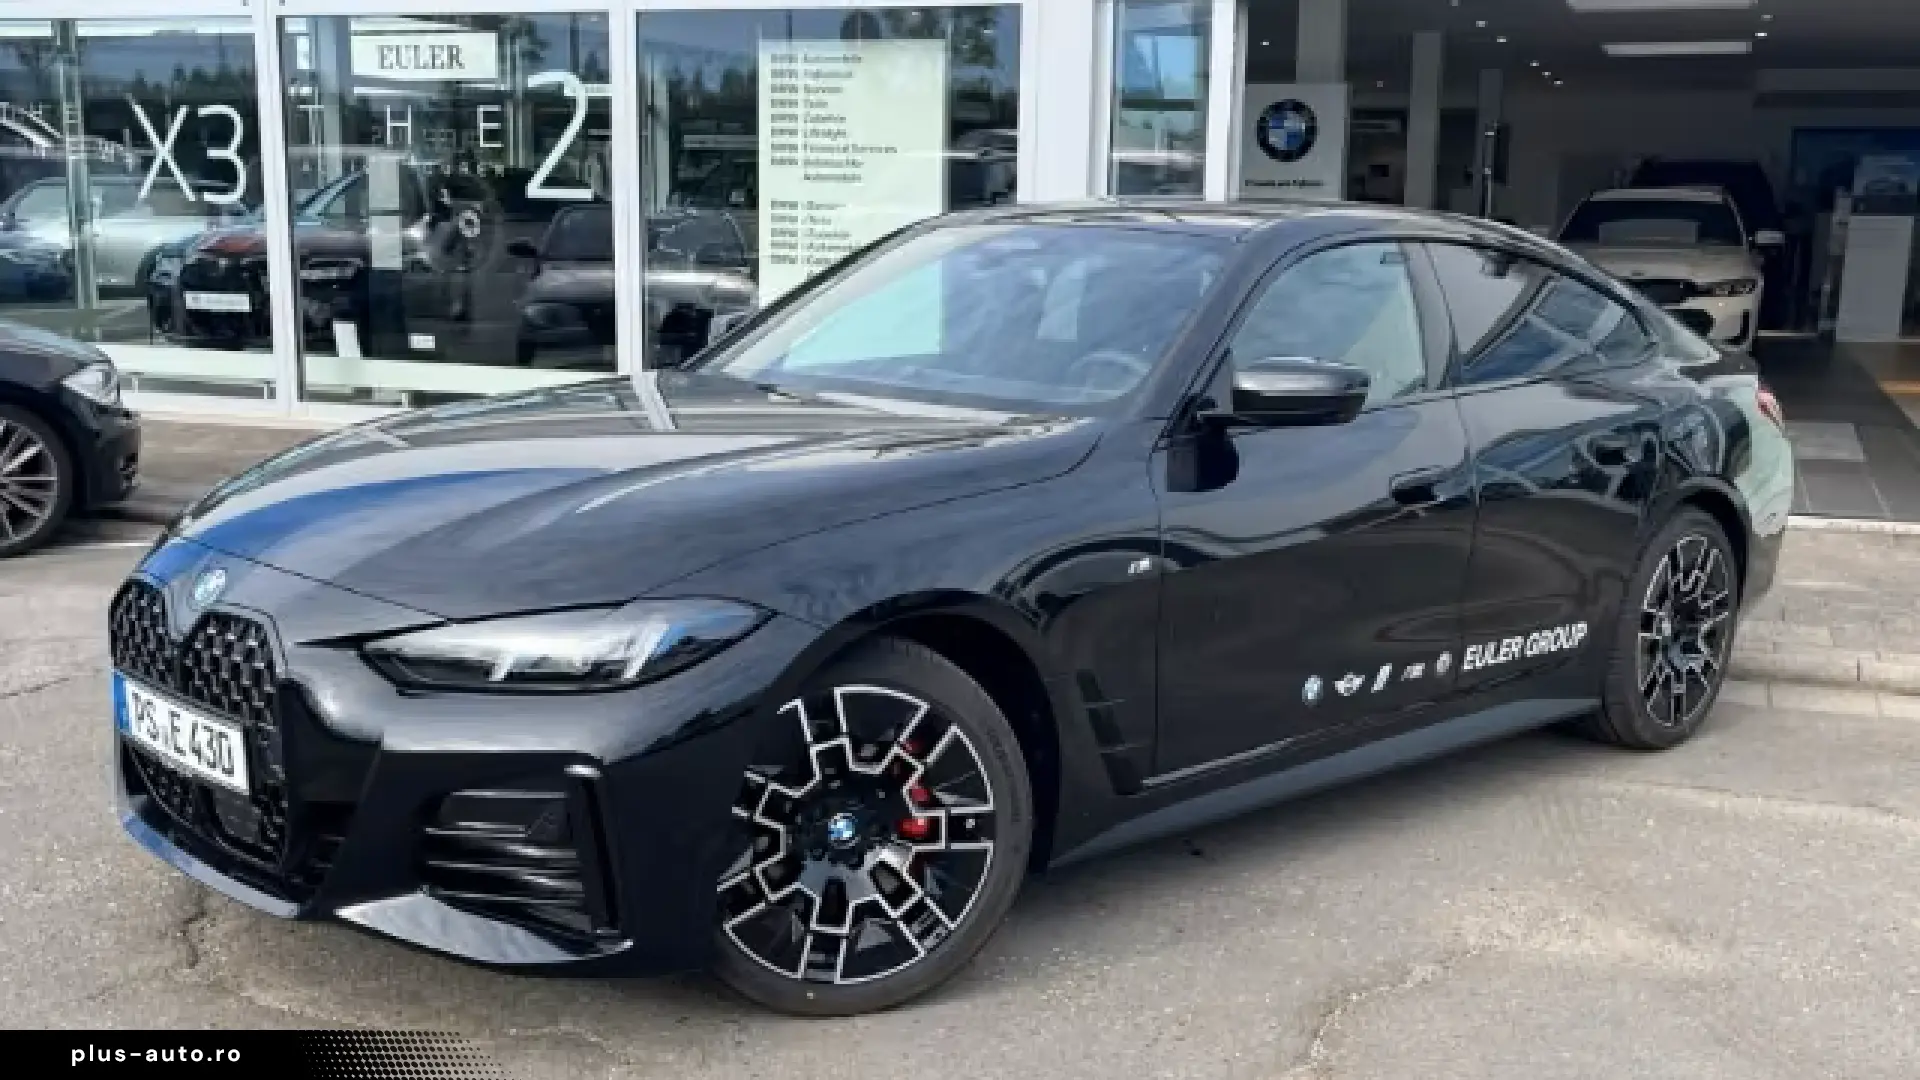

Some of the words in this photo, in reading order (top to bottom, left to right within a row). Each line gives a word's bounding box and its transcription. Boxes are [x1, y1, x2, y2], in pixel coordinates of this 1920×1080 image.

[376, 44, 466, 70] EULER
[132, 104, 247, 204] X3
[526, 71, 595, 200] 2
[1461, 635, 1525, 672] EULER
[1526, 620, 1588, 658] GROUP
[131, 692, 161, 742] PS
[169, 710, 188, 755] E
[190, 719, 236, 778] 430
